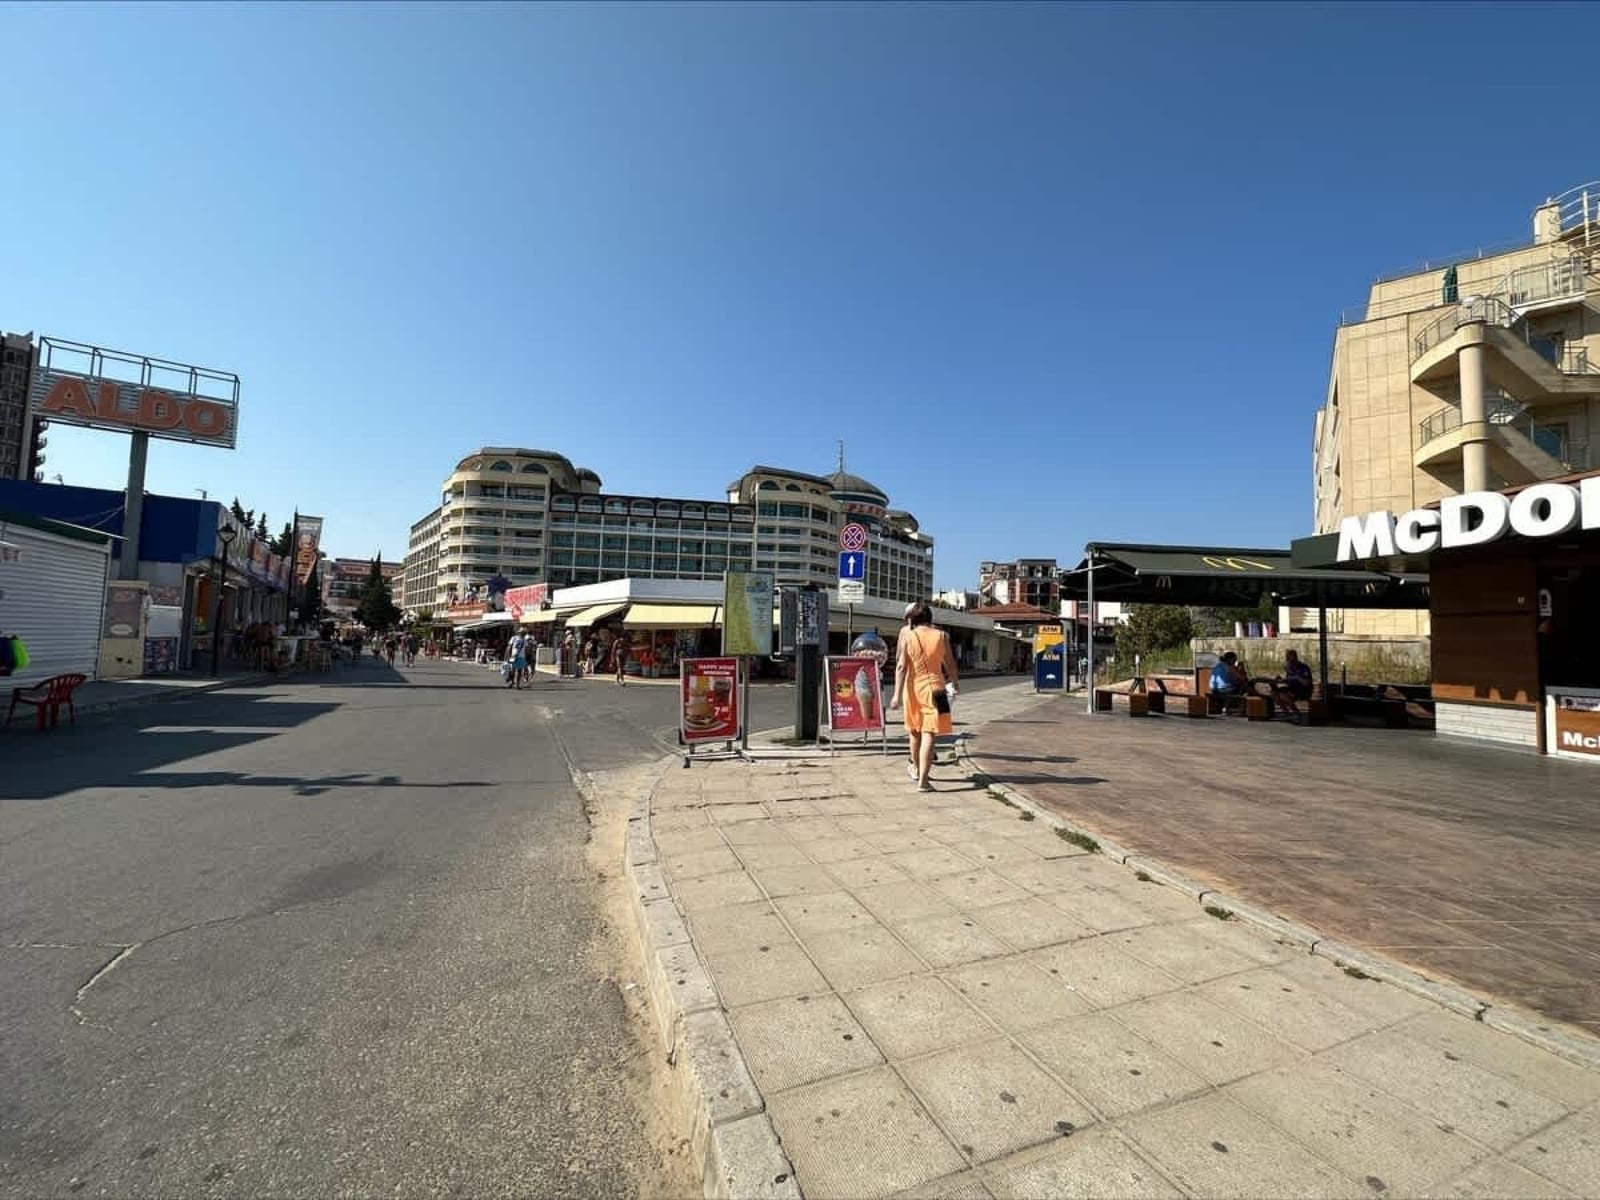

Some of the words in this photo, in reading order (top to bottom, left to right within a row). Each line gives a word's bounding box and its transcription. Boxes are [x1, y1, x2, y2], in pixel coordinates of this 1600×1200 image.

[40, 377, 228, 436] ALDO
[1042, 625, 1058, 634] ATM
[1042, 653, 1060, 661] ATM
[1563, 731, 1600, 749] Mc
